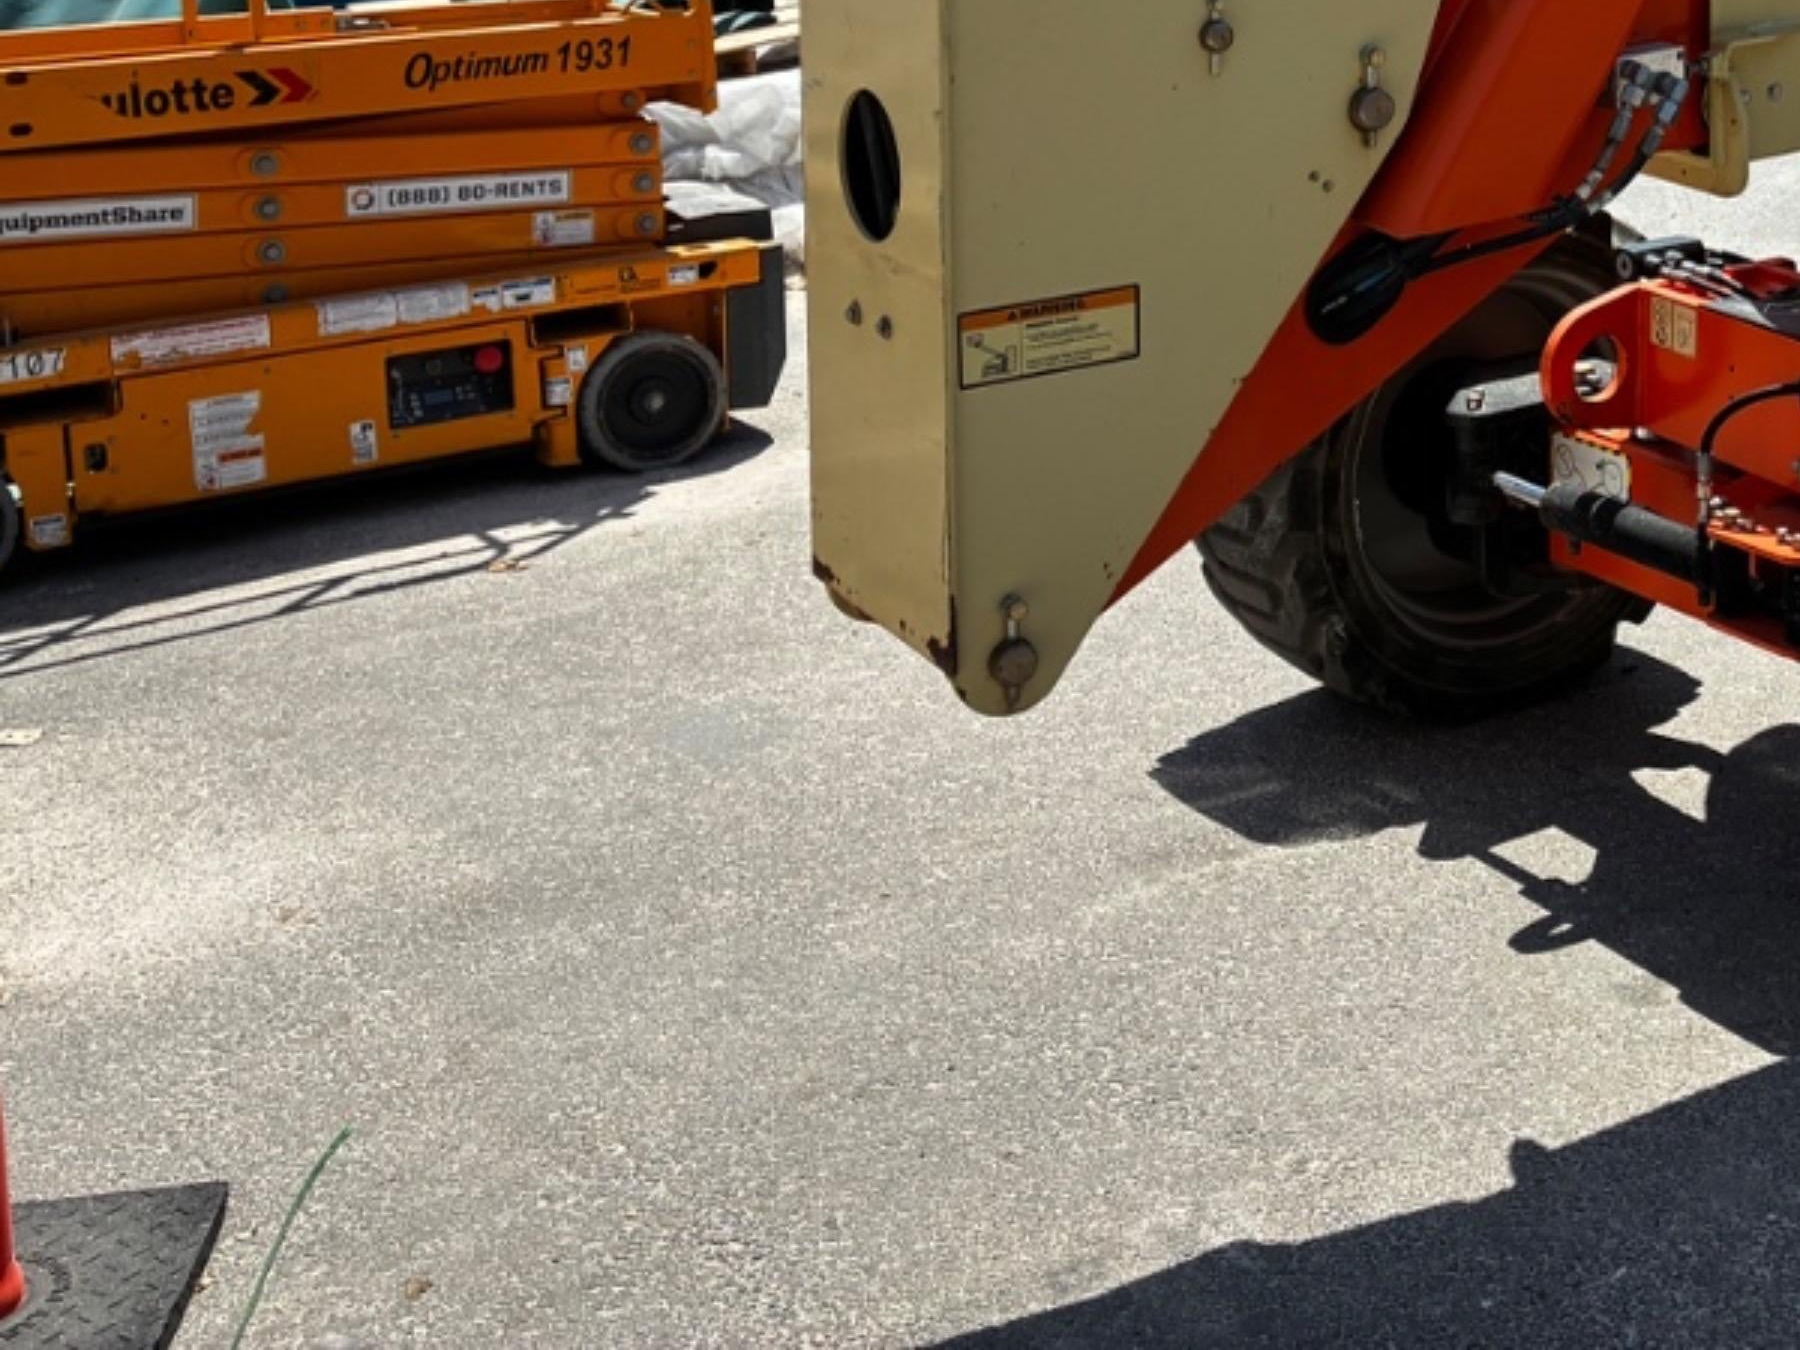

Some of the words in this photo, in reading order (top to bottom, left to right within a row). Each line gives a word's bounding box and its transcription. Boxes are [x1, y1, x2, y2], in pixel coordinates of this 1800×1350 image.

[403, 51, 549, 92] Optimum
[556, 35, 633, 74] 1931
[387, 187, 451, 209] (888)
[456, 178, 563, 202] 80-RENTS
[0, 205, 186, 235] uipmentShare
